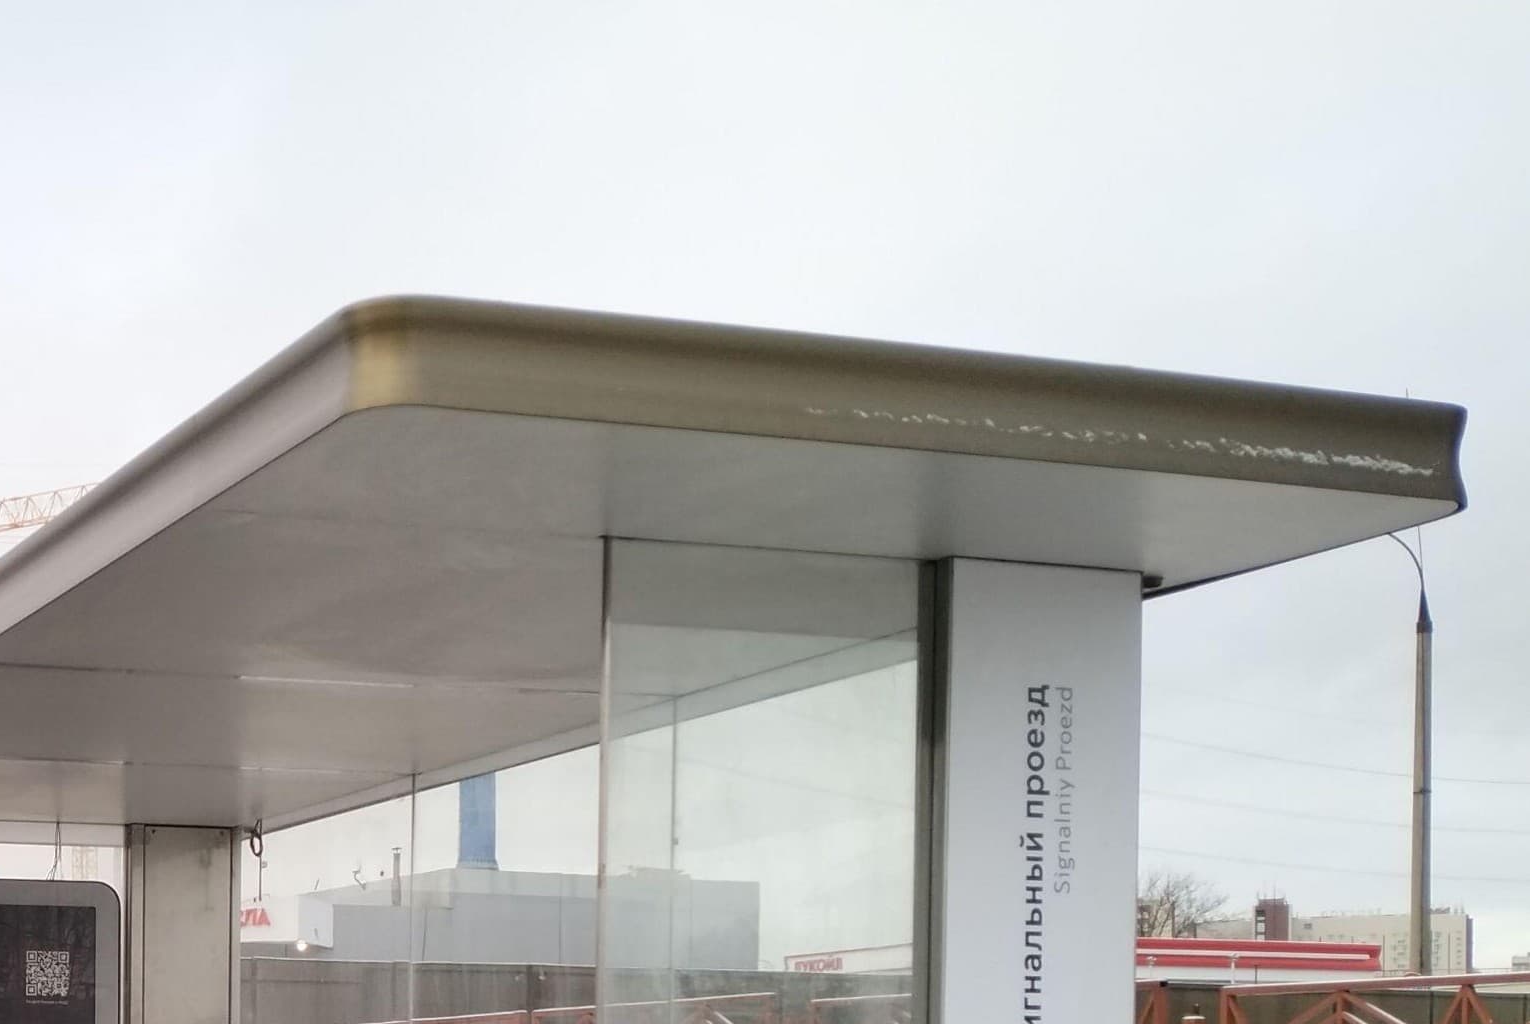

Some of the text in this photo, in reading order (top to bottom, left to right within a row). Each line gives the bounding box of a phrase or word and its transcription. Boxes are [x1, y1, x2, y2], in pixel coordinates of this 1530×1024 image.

[1026, 684, 1050, 818] проезд
[1053, 686, 1075, 894] Signalniy Proezd
